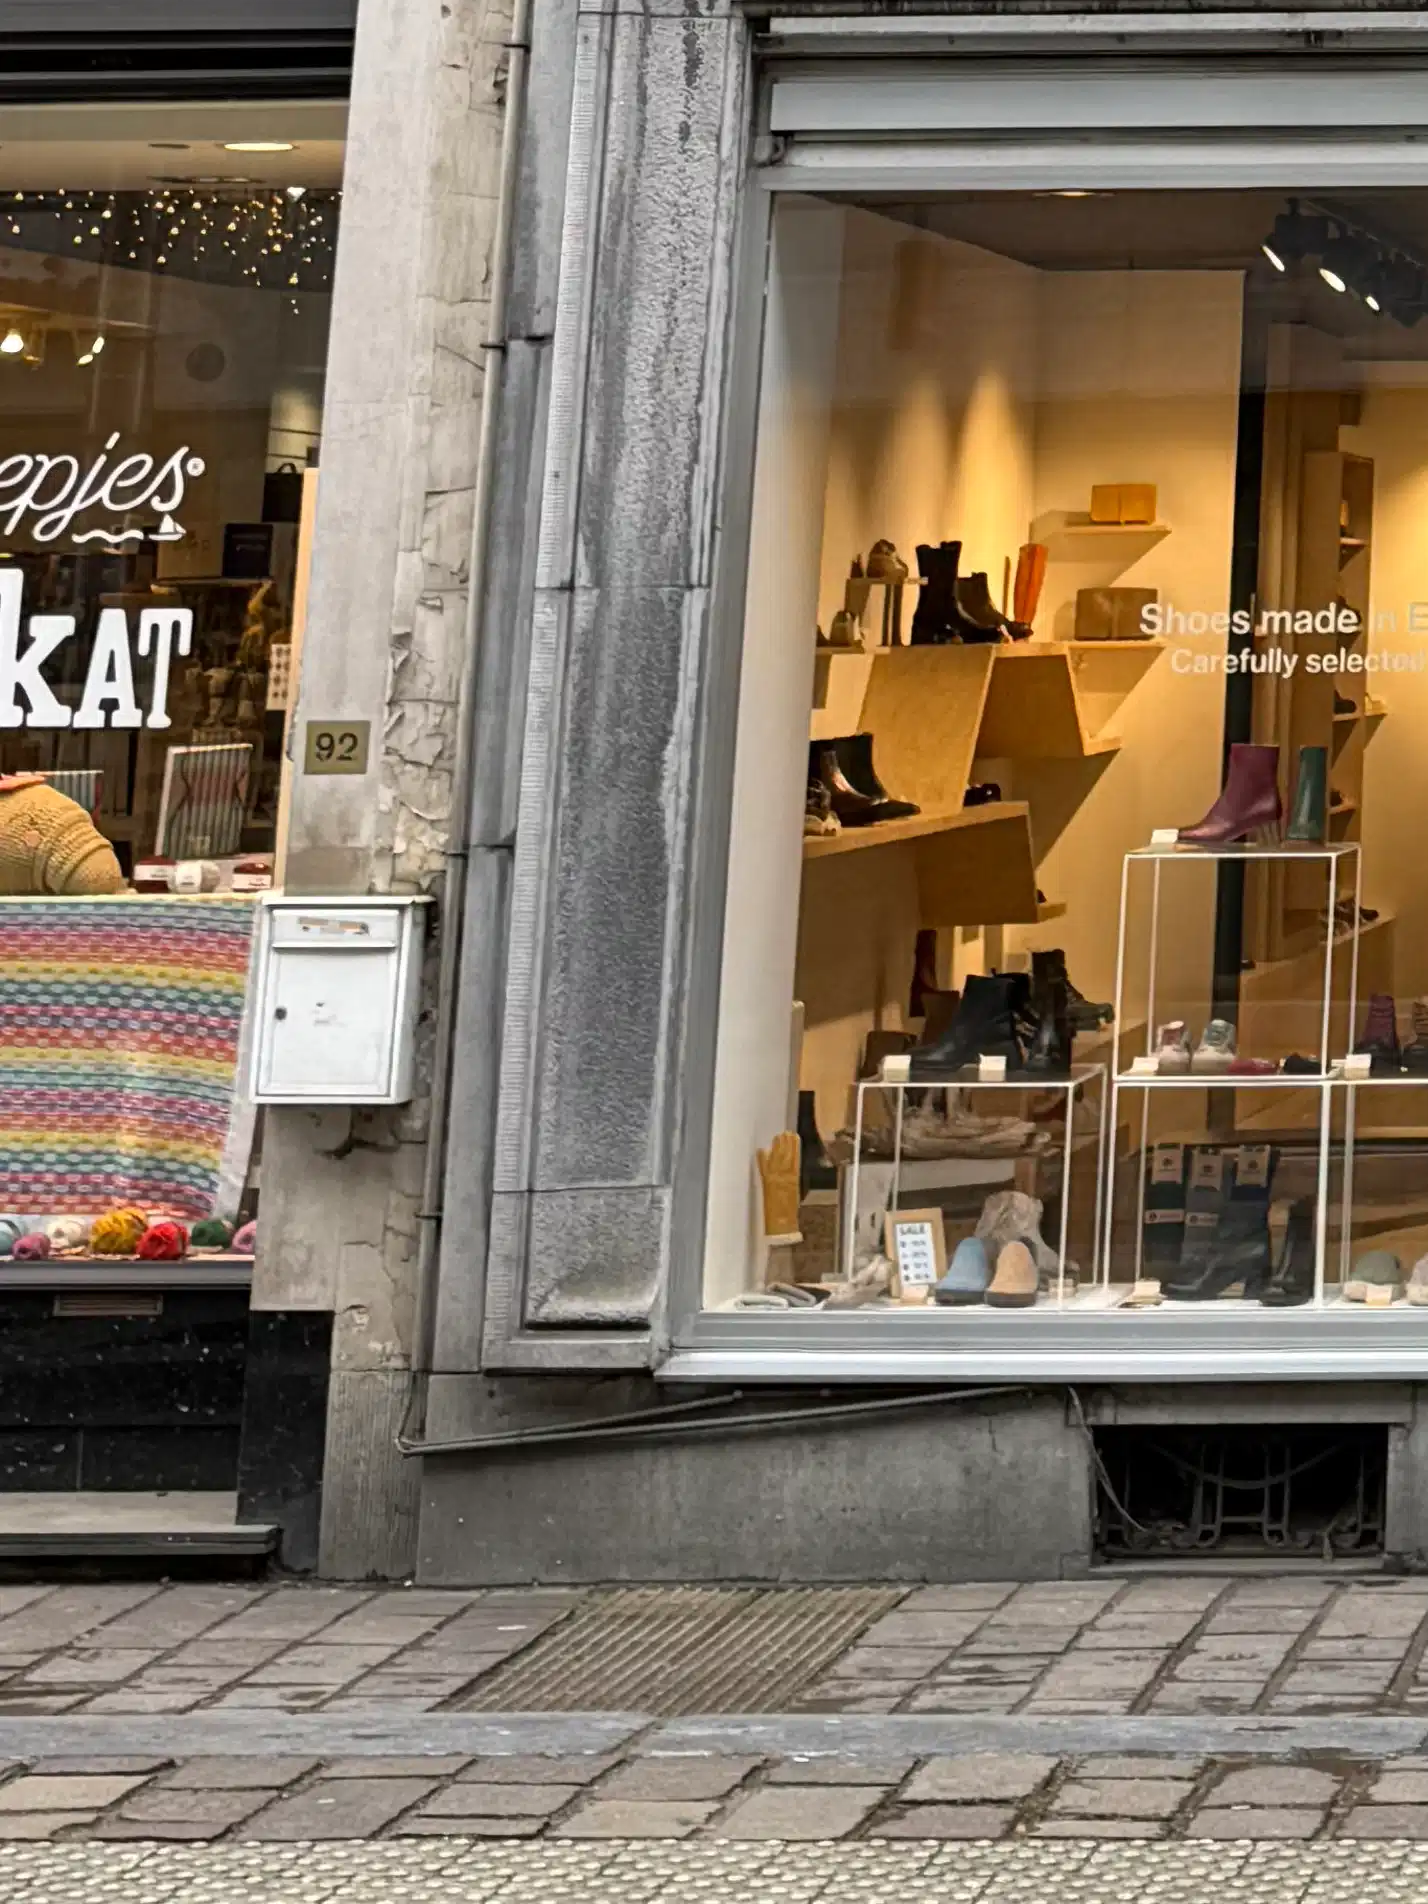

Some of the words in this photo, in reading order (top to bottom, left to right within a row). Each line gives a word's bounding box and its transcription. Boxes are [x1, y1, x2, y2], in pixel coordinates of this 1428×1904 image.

[1139, 603, 1251, 636] Shoes
[1260, 602, 1361, 635] made
[1170, 647, 1298, 679] Carefully
[1304, 648, 1426, 673] selected
[315, 731, 359, 763] 92
